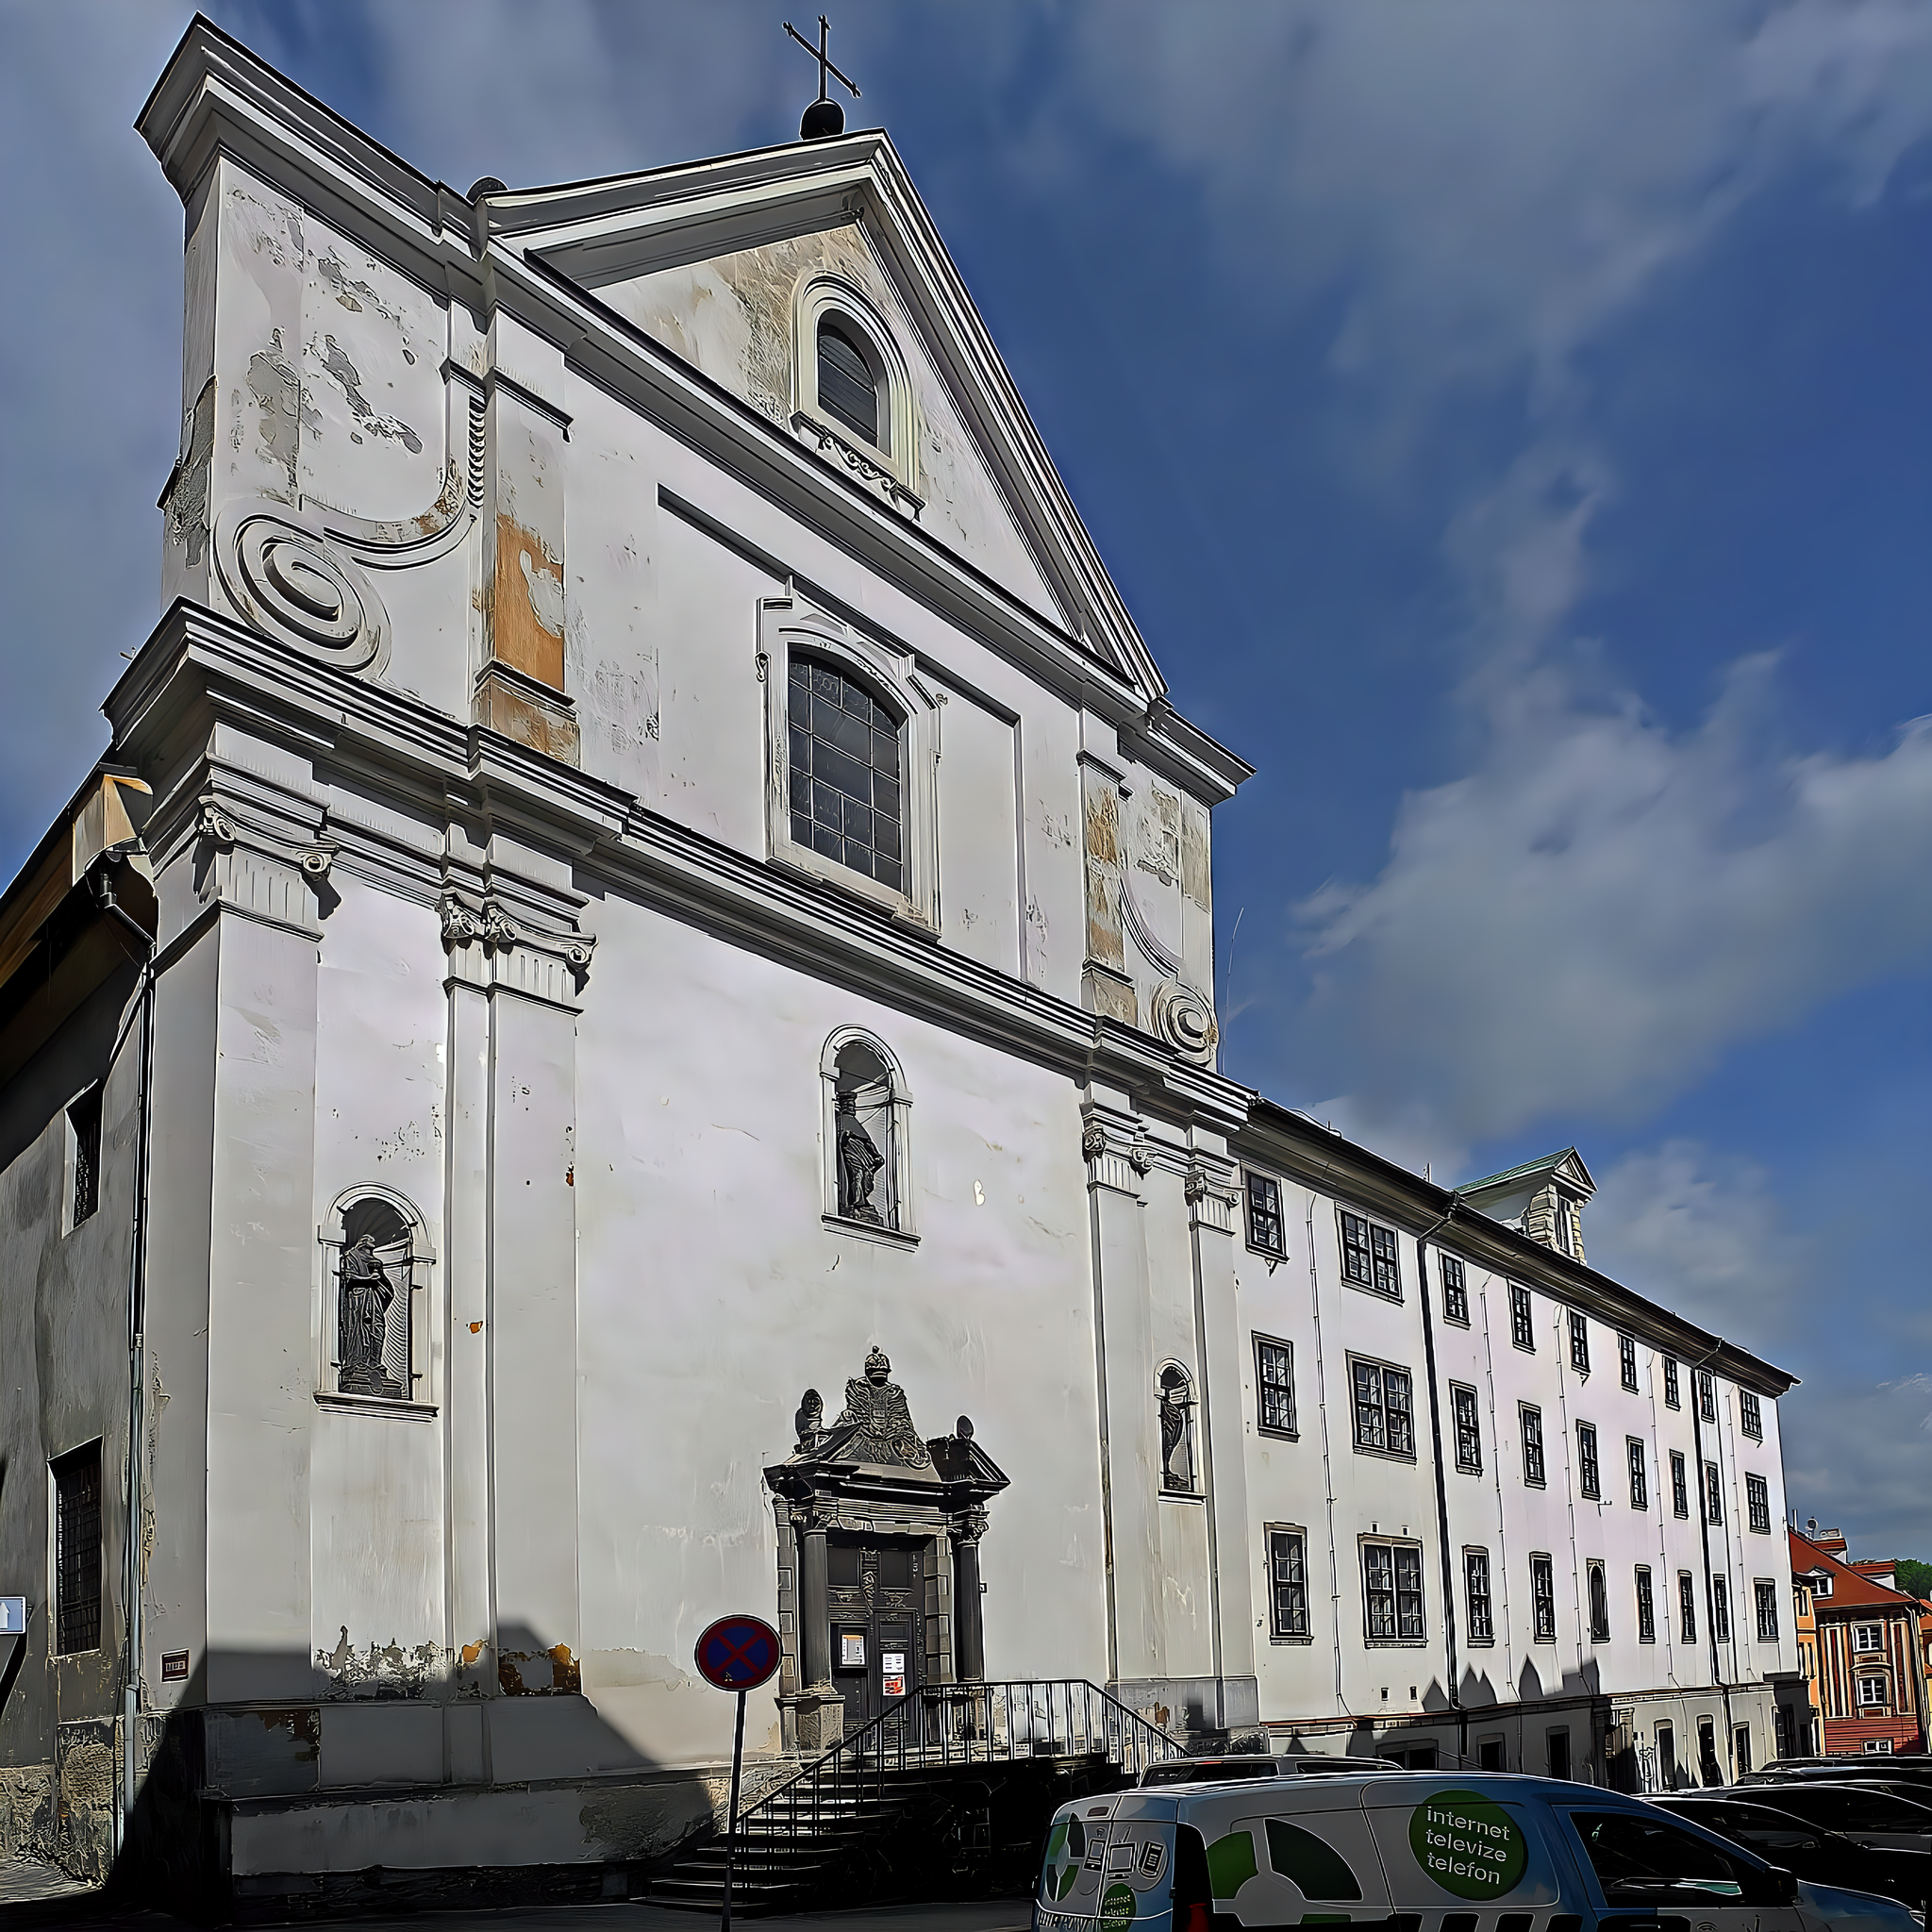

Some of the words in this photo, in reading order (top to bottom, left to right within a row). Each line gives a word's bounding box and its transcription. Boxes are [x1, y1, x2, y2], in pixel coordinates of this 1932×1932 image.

[1426, 1806, 1510, 1840] internet
[1425, 1828, 1507, 1862] televize
[1426, 1852, 1500, 1885] telefon
